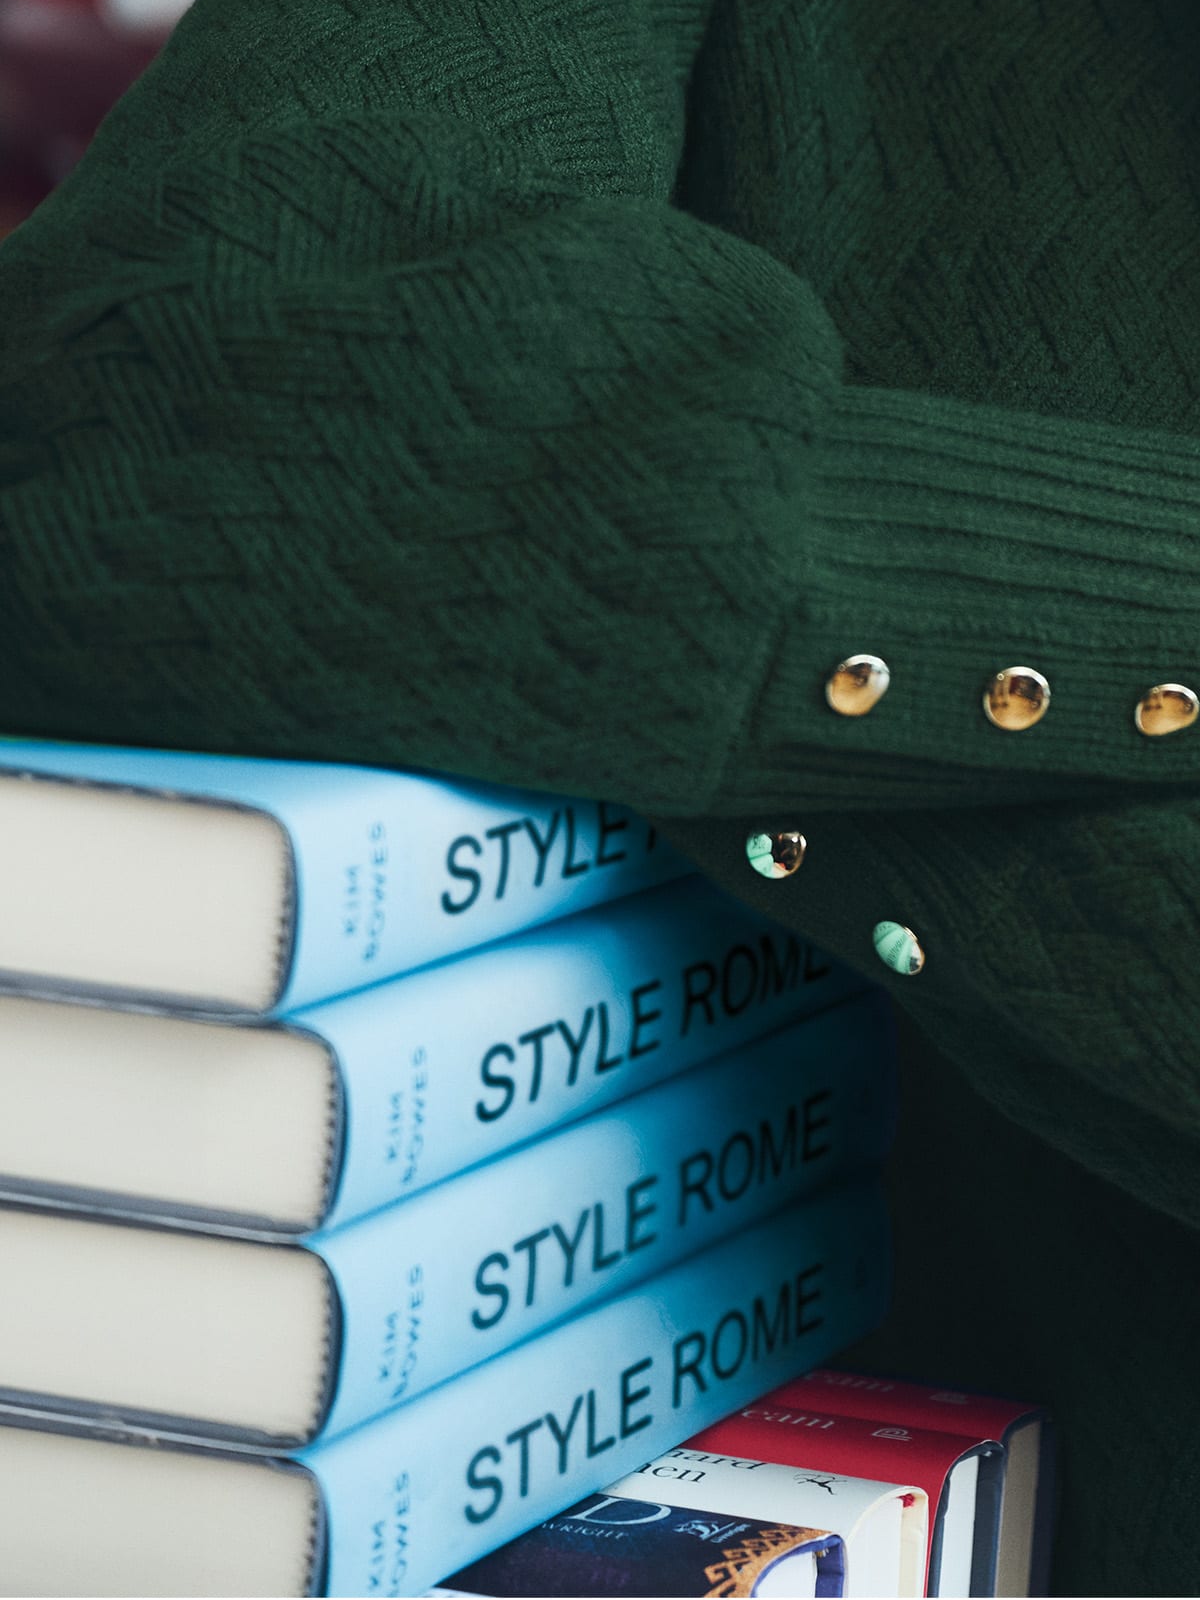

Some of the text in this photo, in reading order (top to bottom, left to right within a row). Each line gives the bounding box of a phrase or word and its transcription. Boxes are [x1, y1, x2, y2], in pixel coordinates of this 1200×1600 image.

[342, 864, 360, 937] KIM
[441, 802, 628, 914] STYLE
[476, 980, 661, 1122] STYLE
[384, 1091, 402, 1163] KIM
[471, 1089, 832, 1330] STYLE ROME
[378, 1311, 398, 1383] KIM
[464, 1263, 824, 1524] STYLE ROME
[368, 1520, 386, 1592] KIM
